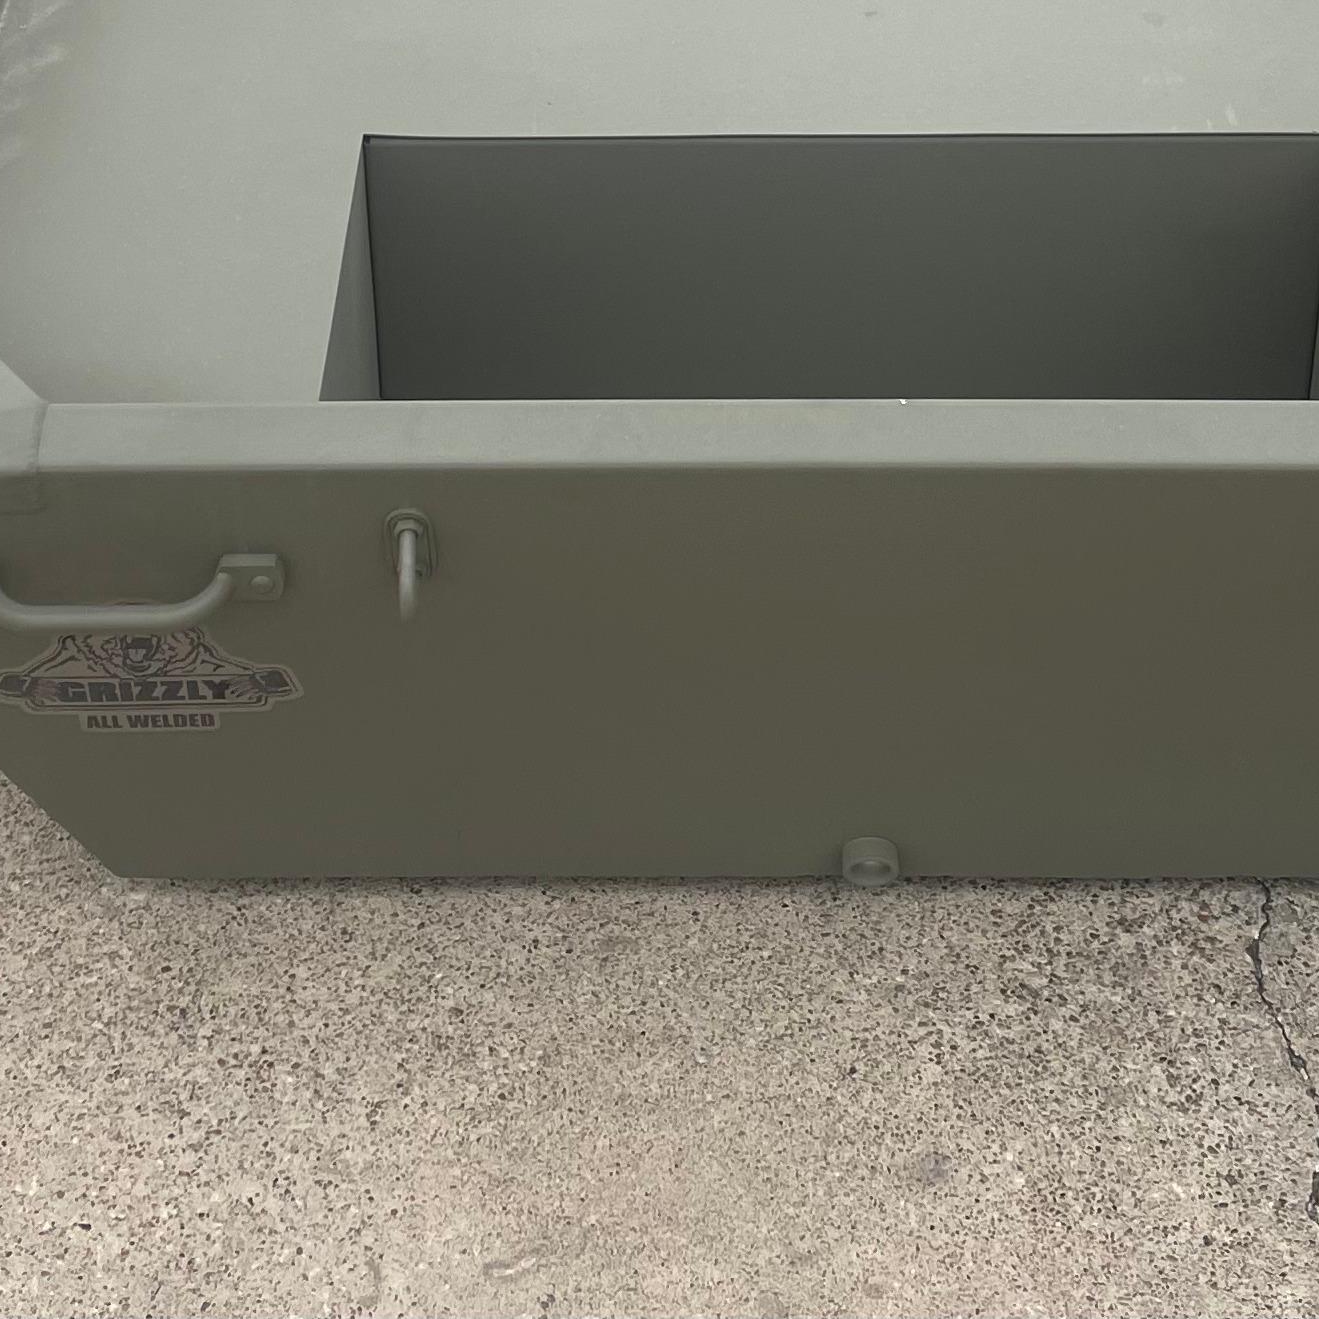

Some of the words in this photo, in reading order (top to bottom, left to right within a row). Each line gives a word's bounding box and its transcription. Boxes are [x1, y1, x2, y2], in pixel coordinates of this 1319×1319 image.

[56, 679, 232, 702] GRIZZLY
[86, 714, 123, 729] ALL
[126, 713, 216, 729] WELDED
